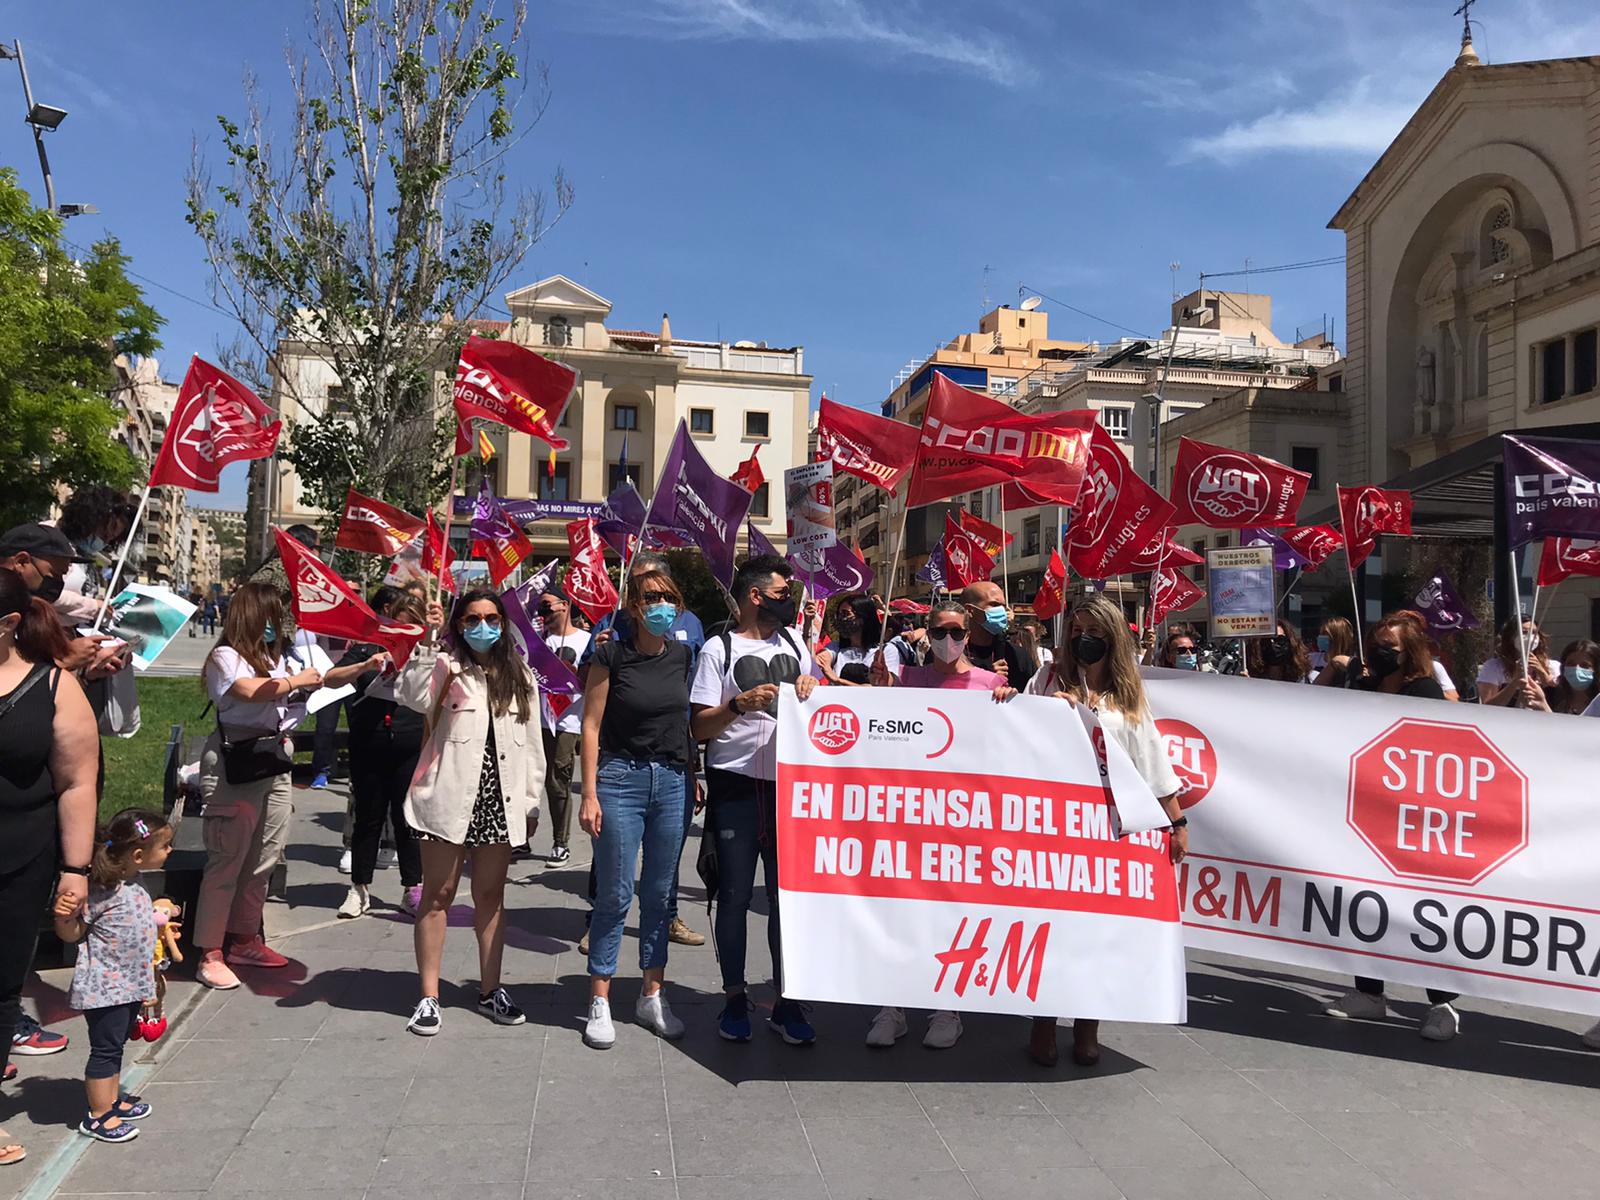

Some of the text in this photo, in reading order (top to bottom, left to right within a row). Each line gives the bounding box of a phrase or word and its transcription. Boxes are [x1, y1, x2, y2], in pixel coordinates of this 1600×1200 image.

[1199, 464, 1260, 499] UGT
[563, 506, 585, 514] MIRES
[793, 532, 828, 545] LOW COST
[1217, 552, 1260, 560] NUESTROS
[814, 711, 854, 733] UGT
[868, 719, 923, 735] FeSMC
[1161, 733, 1205, 773] GT
[1381, 745, 1496, 801] STOP
[791, 782, 833, 820] EN
[842, 784, 993, 830] DEFENSA
[1001, 793, 1058, 837] DEL
[1397, 804, 1477, 858] ERE
[814, 835, 1154, 900] NO AL ERE SALVAJE DE
[1302, 882, 1389, 943] NO
[1410, 898, 1600, 977] SOBR
[933, 916, 1050, 1002] H&M
